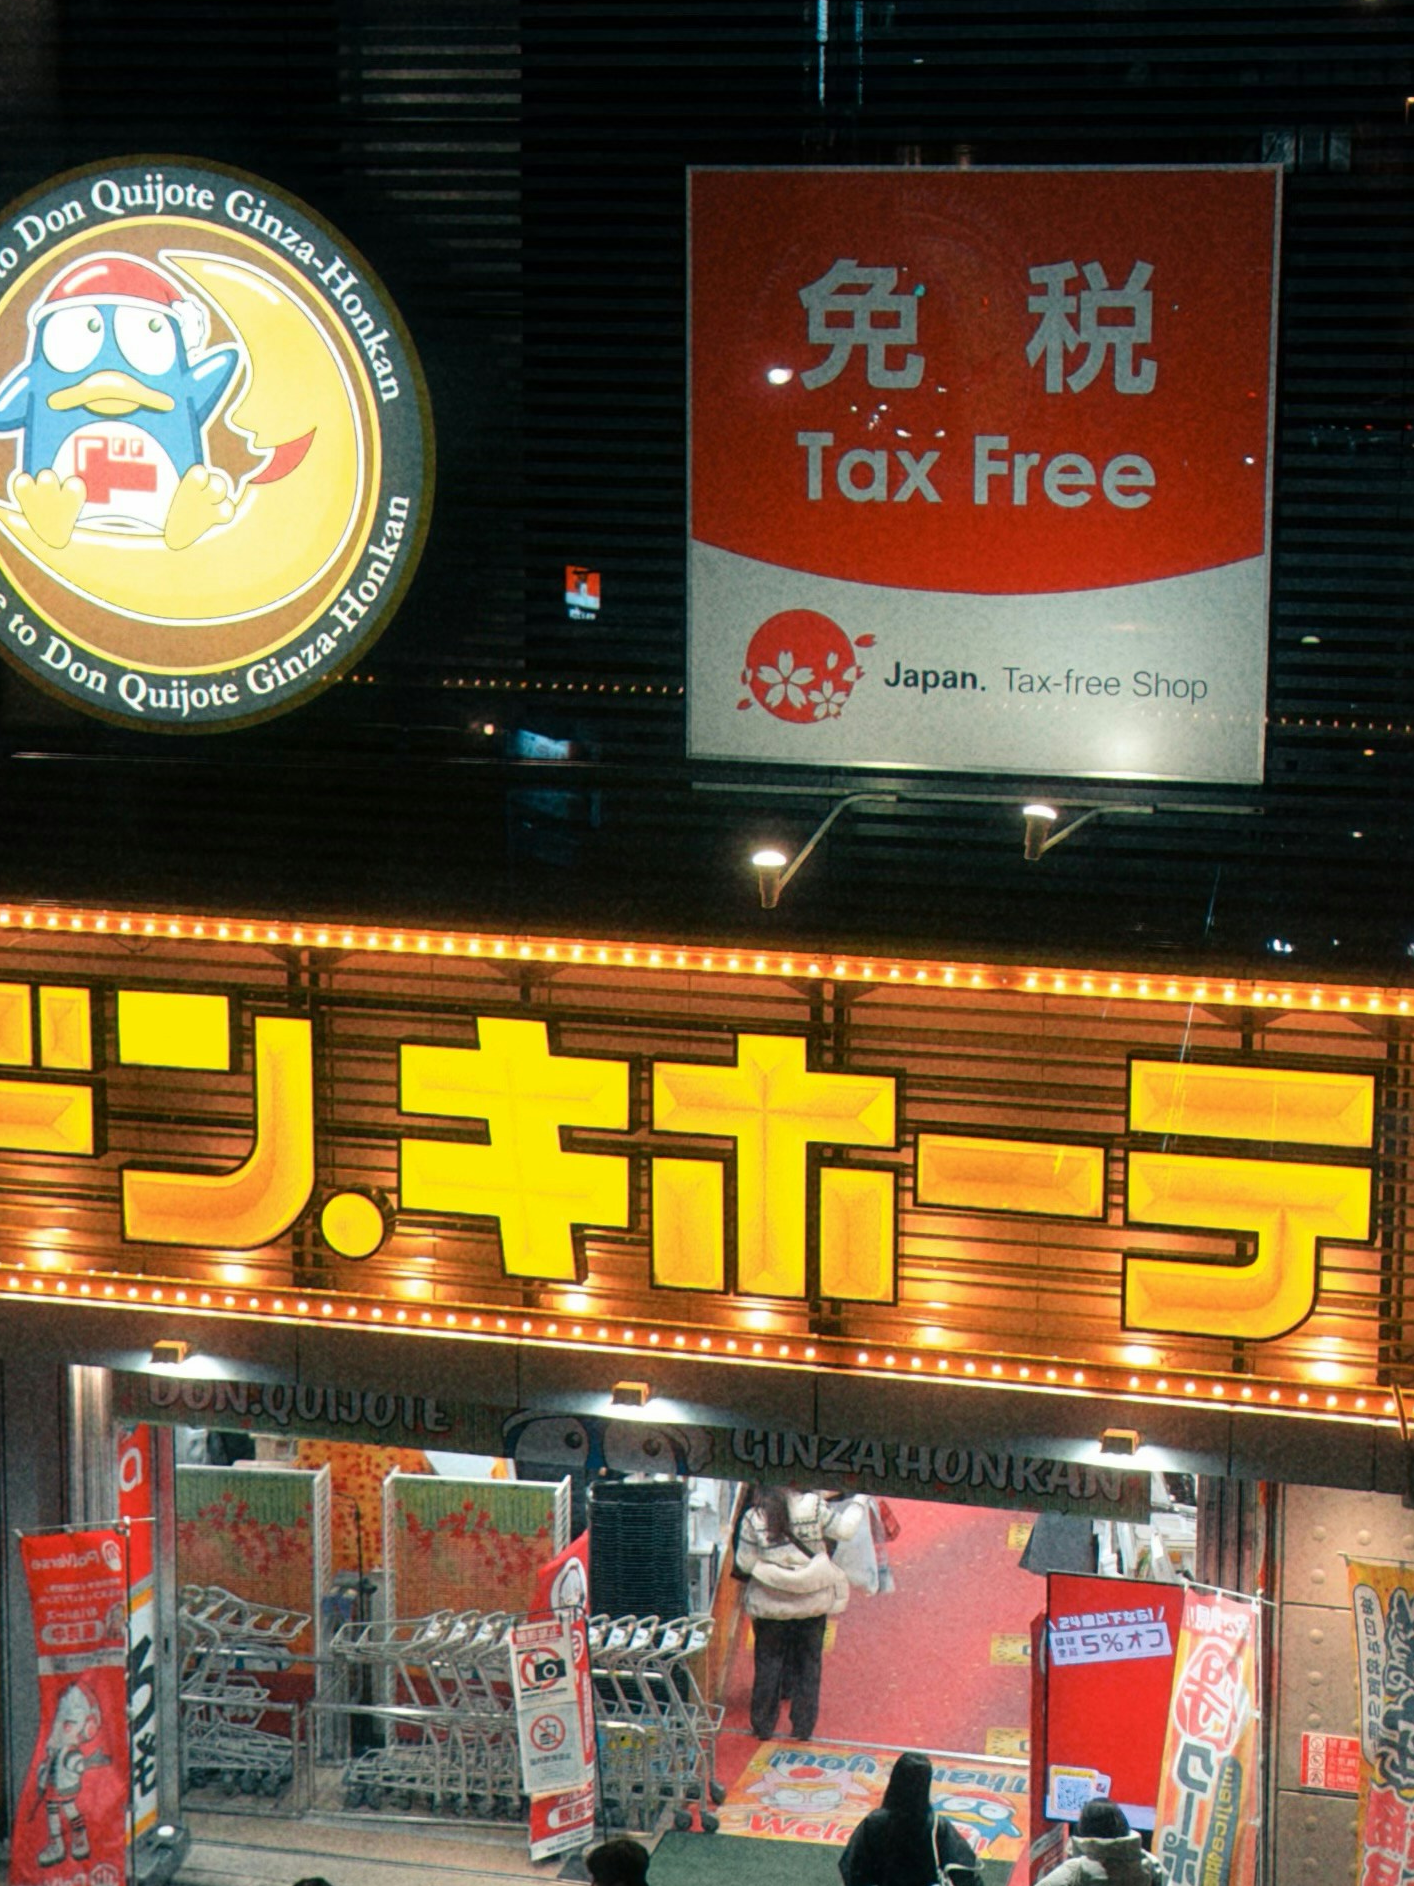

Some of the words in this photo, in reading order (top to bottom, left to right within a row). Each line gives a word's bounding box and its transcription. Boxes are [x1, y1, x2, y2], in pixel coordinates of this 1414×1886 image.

[14, 197, 87, 253] Don
[91, 174, 215, 213] Quijote
[224, 189, 401, 403] Ginza-Honkan
[798, 258, 1158, 395] 免税
[797, 432, 942, 503] Tax
[973, 434, 1157, 509] Free
[7, 612, 38, 646] to
[41, 637, 109, 694] Don
[117, 674, 240, 716] Quijote
[245, 495, 410, 694] Ginza-Honkan
[884, 661, 986, 696] Japan.
[1002, 666, 1121, 698] Tax-free
[1132, 670, 1209, 705] Shop
[731, 1425, 886, 1479] GINZA
[895, 1442, 1122, 1502] HONKAN
